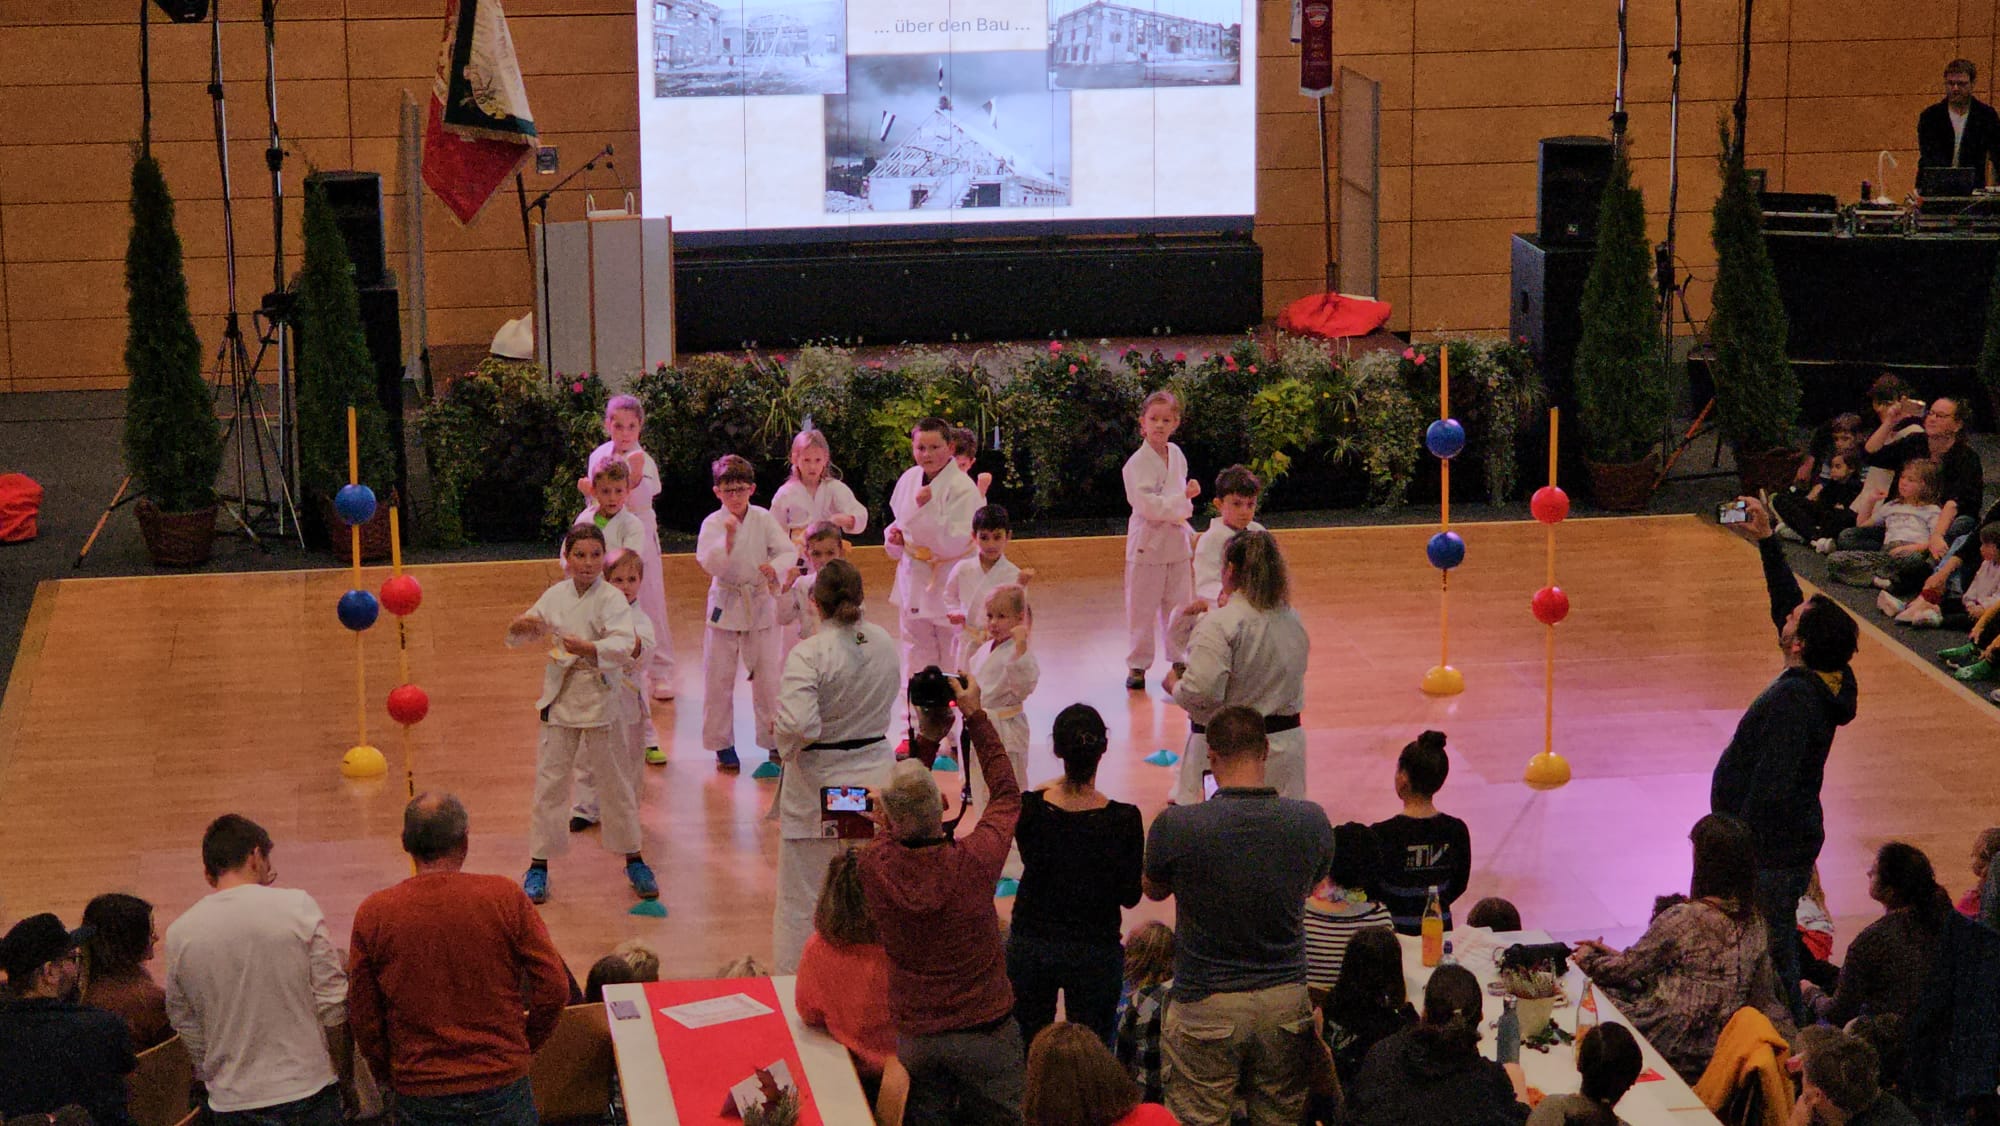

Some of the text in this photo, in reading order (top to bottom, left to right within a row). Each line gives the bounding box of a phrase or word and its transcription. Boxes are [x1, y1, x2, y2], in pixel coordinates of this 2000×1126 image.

[894, 19, 934, 33] über
[938, 18, 972, 33] den
[976, 17, 1010, 32] Bau
